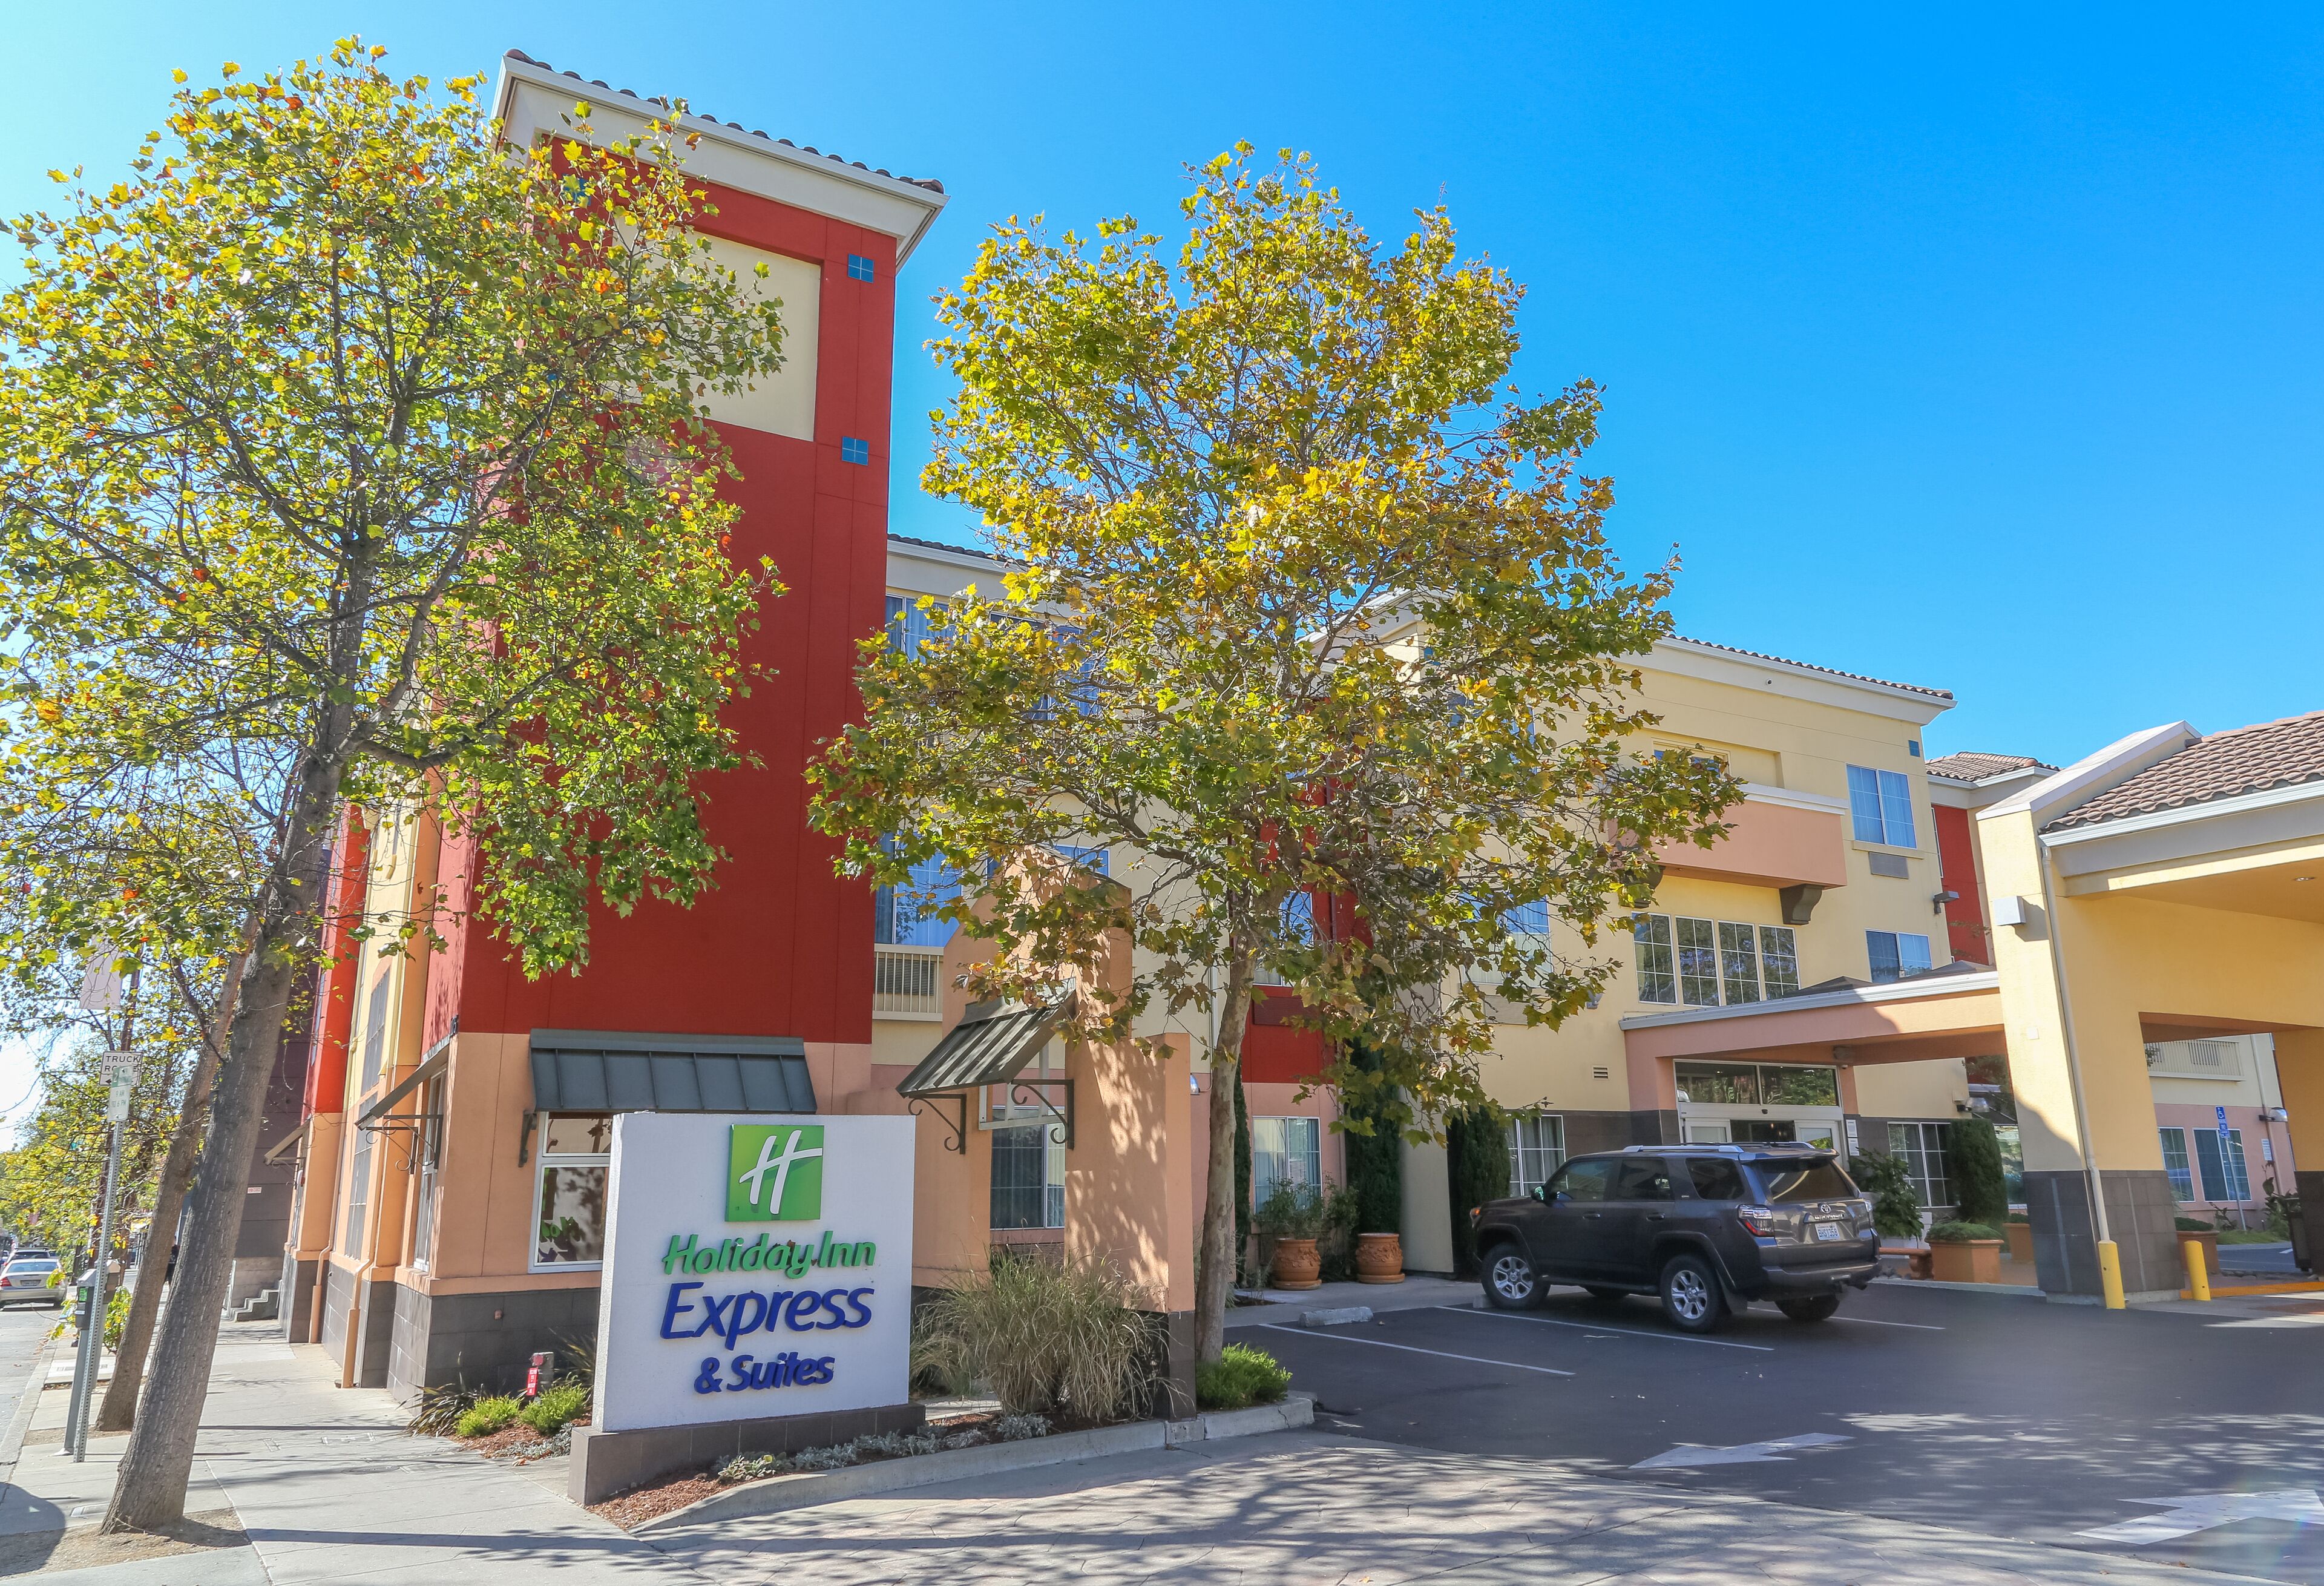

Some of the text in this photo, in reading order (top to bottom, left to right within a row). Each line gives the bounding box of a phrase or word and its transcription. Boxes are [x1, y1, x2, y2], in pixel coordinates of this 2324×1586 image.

[662, 1231, 876, 1279] Holiday Inn
[660, 1282, 875, 1351] Express
[694, 1351, 835, 1394] & Suites
